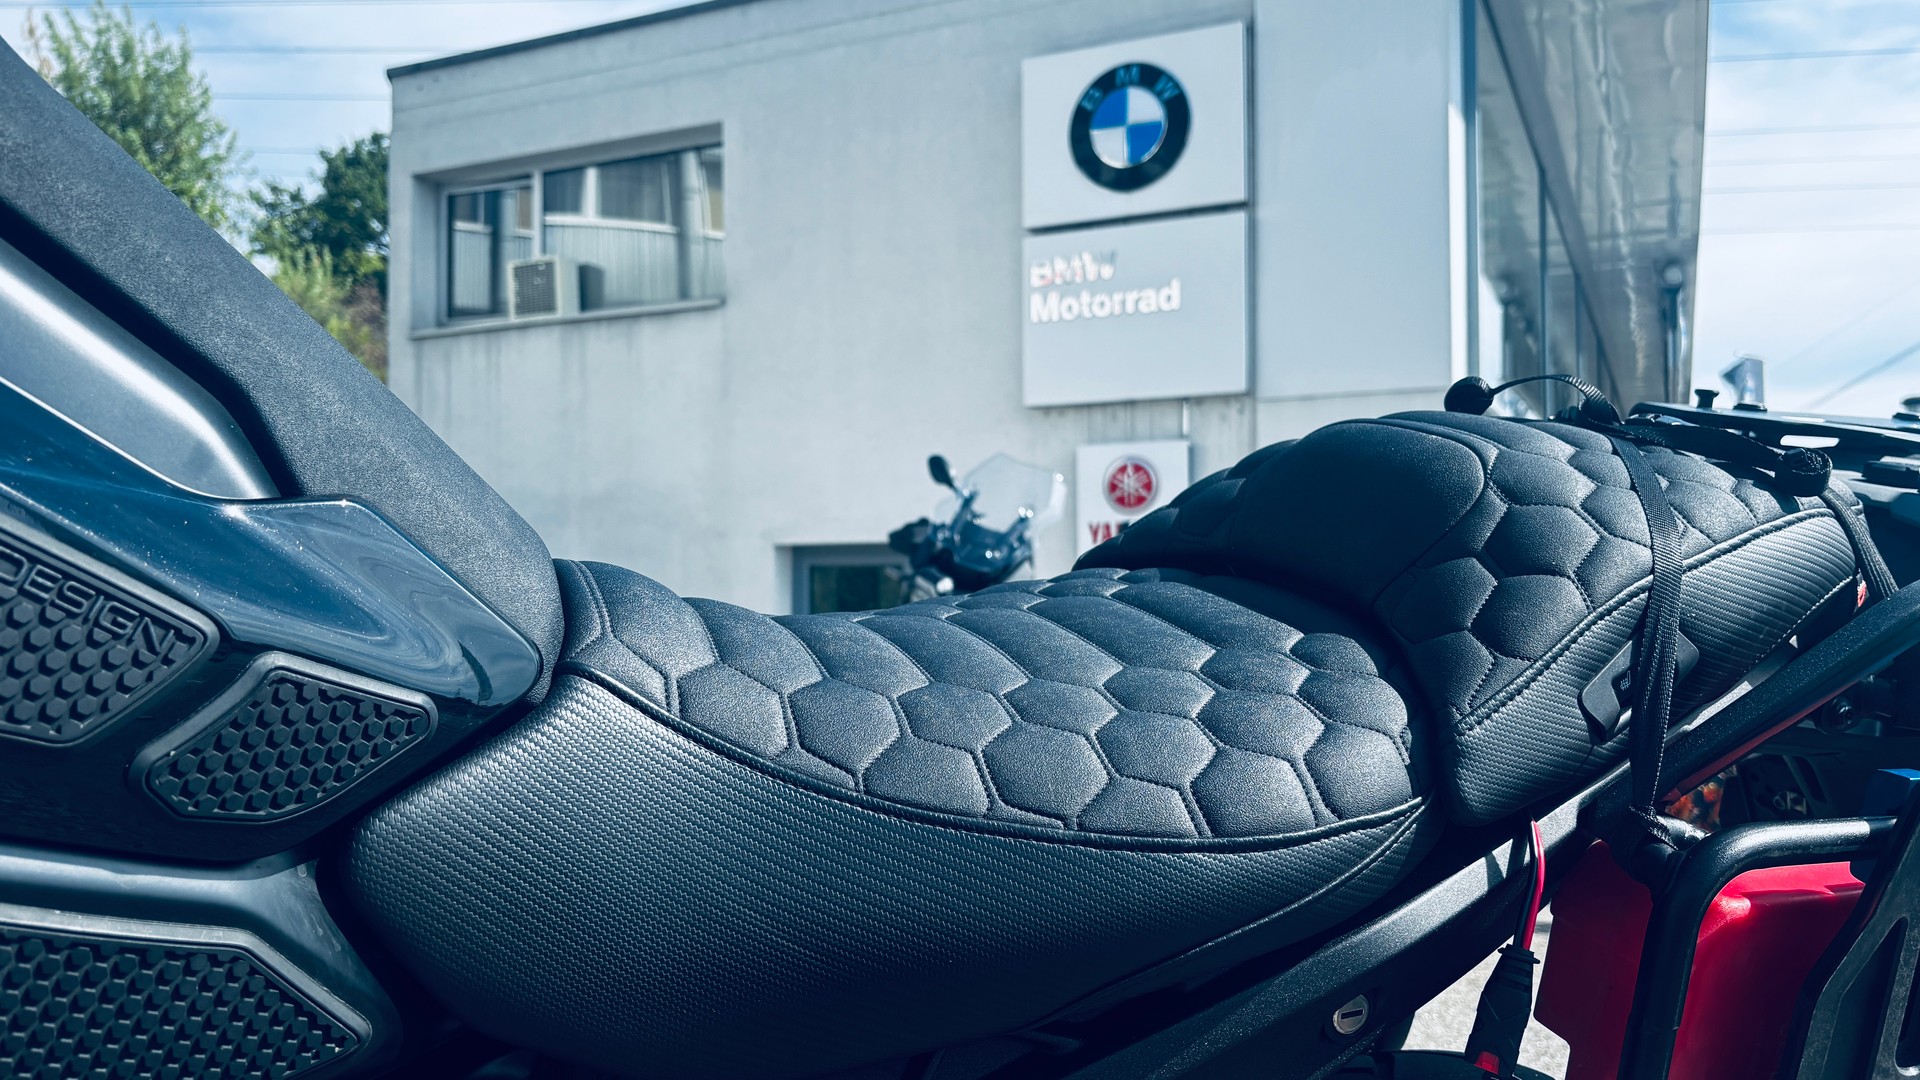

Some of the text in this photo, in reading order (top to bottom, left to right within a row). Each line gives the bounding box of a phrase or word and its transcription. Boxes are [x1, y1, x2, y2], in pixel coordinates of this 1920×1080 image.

[1080, 65, 1181, 110] BMW
[1030, 251, 1117, 288] BMW
[1030, 276, 1181, 324] Motorrad
[0, 546, 175, 655] DESIGN
